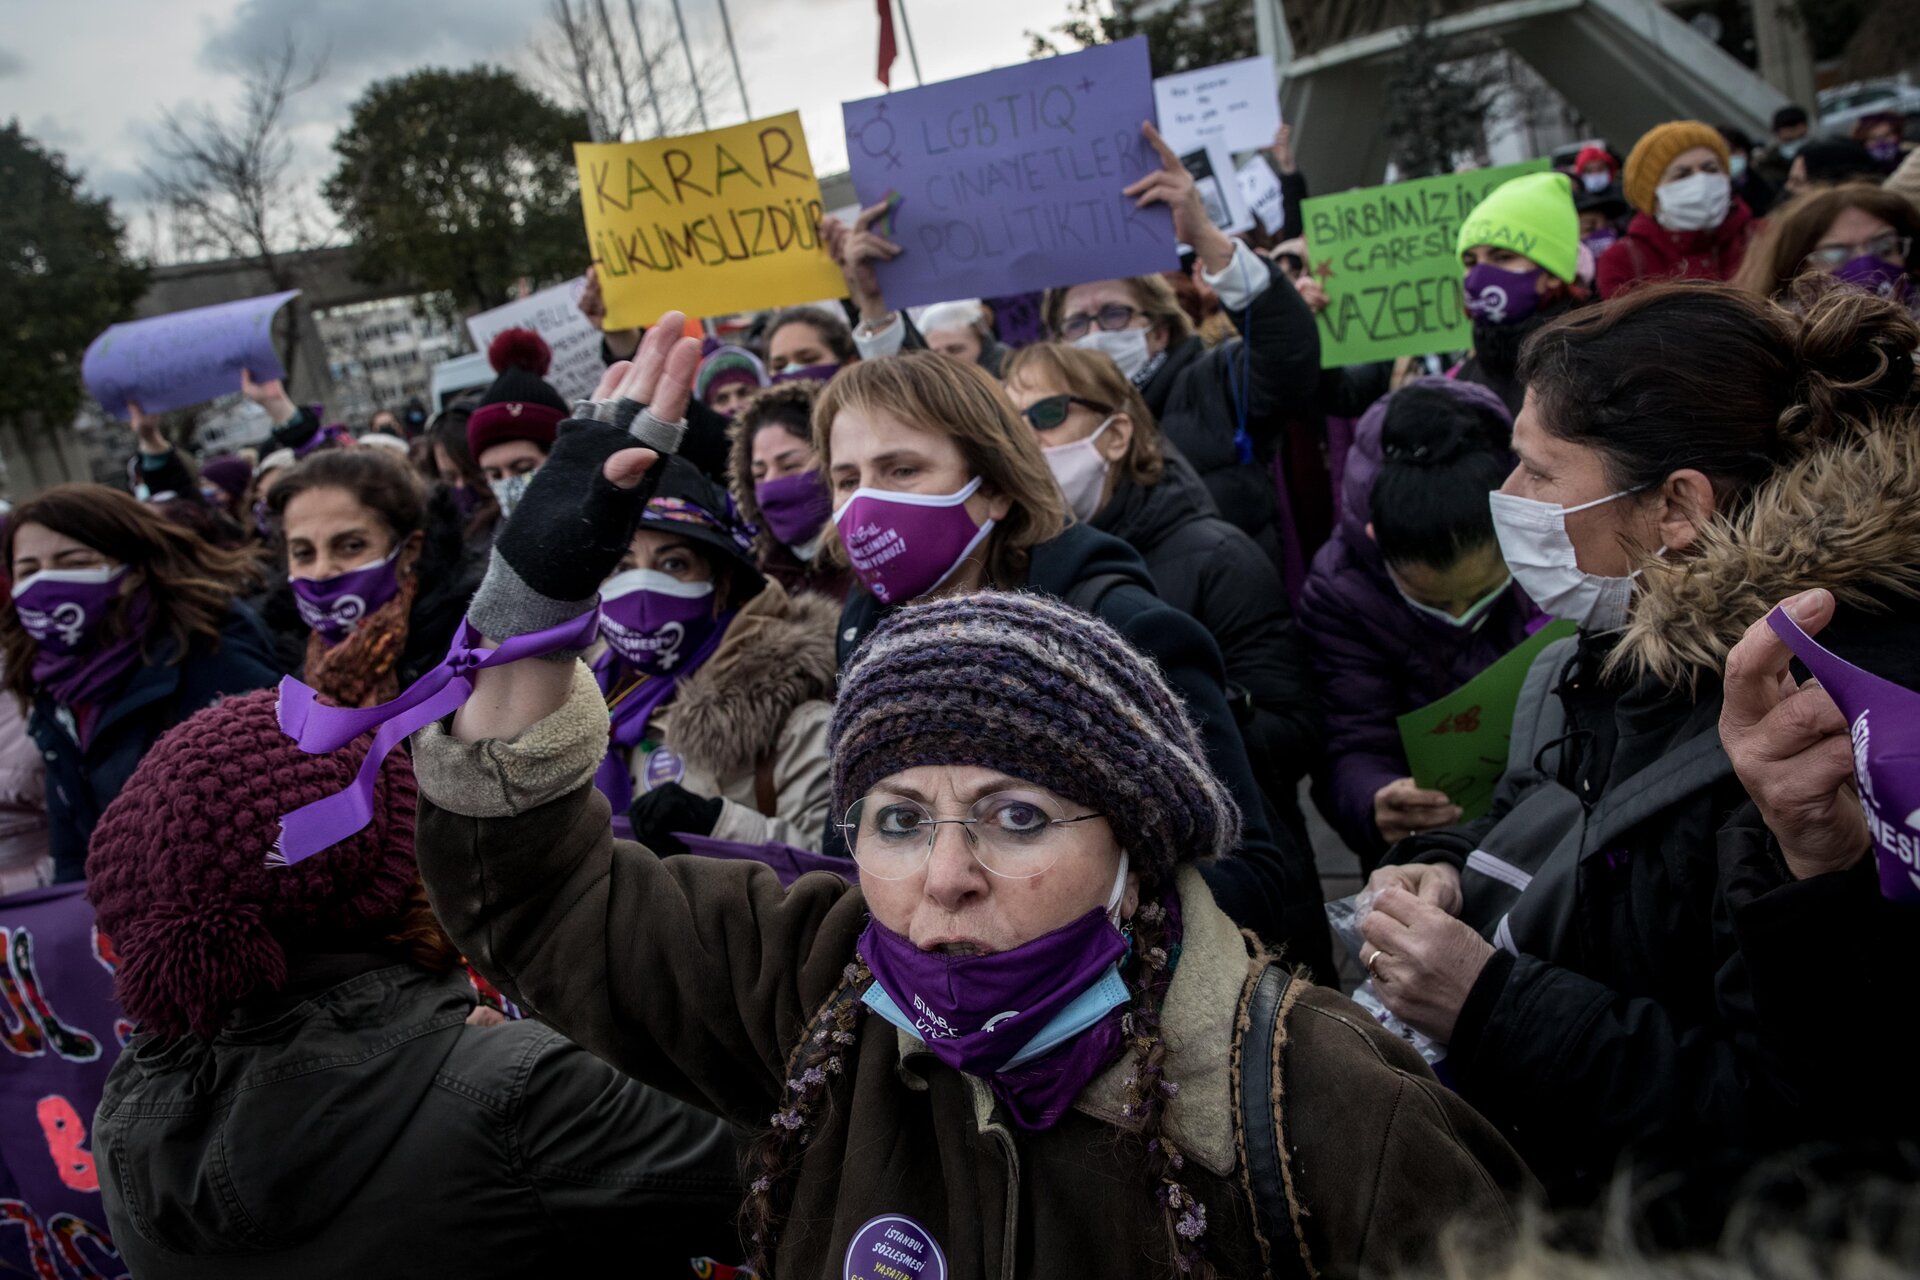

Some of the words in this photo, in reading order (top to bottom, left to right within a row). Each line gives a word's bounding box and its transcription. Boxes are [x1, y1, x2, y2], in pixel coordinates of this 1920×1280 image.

[590, 126, 810, 214] KARAR
[1343, 223, 1459, 274] ÇARESİ
[872, 1241, 927, 1272] SÖZLEŞMESİ
[884, 1225, 924, 1254] İSTANBUL
